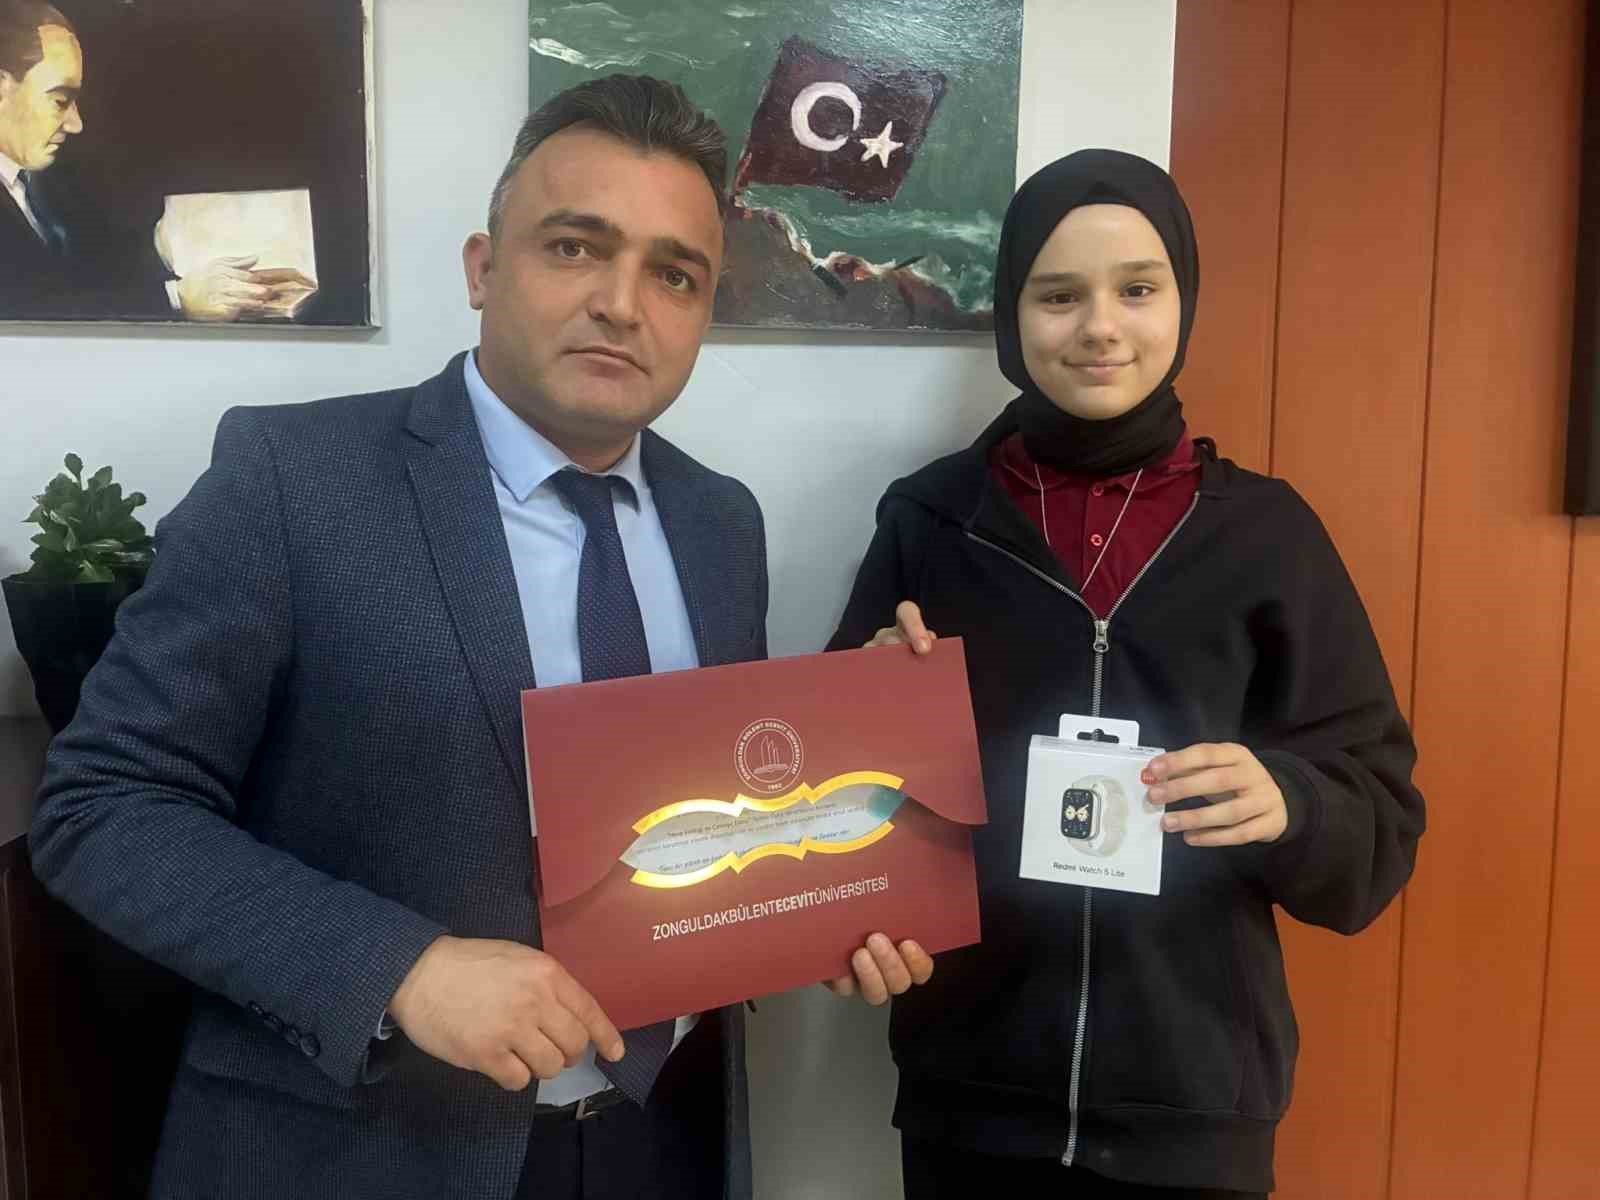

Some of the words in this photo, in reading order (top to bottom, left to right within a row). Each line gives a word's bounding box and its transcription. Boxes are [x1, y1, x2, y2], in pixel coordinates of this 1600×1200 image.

[1053, 862, 1076, 871] Redmi
[1079, 865, 1102, 874] Watch
[1104, 868, 1110, 876] 5
[1111, 868, 1125, 877] Lite
[652, 873, 889, 940] ZONGULDAKBÜLENTECEVİTÜNİVERSİTESİ
